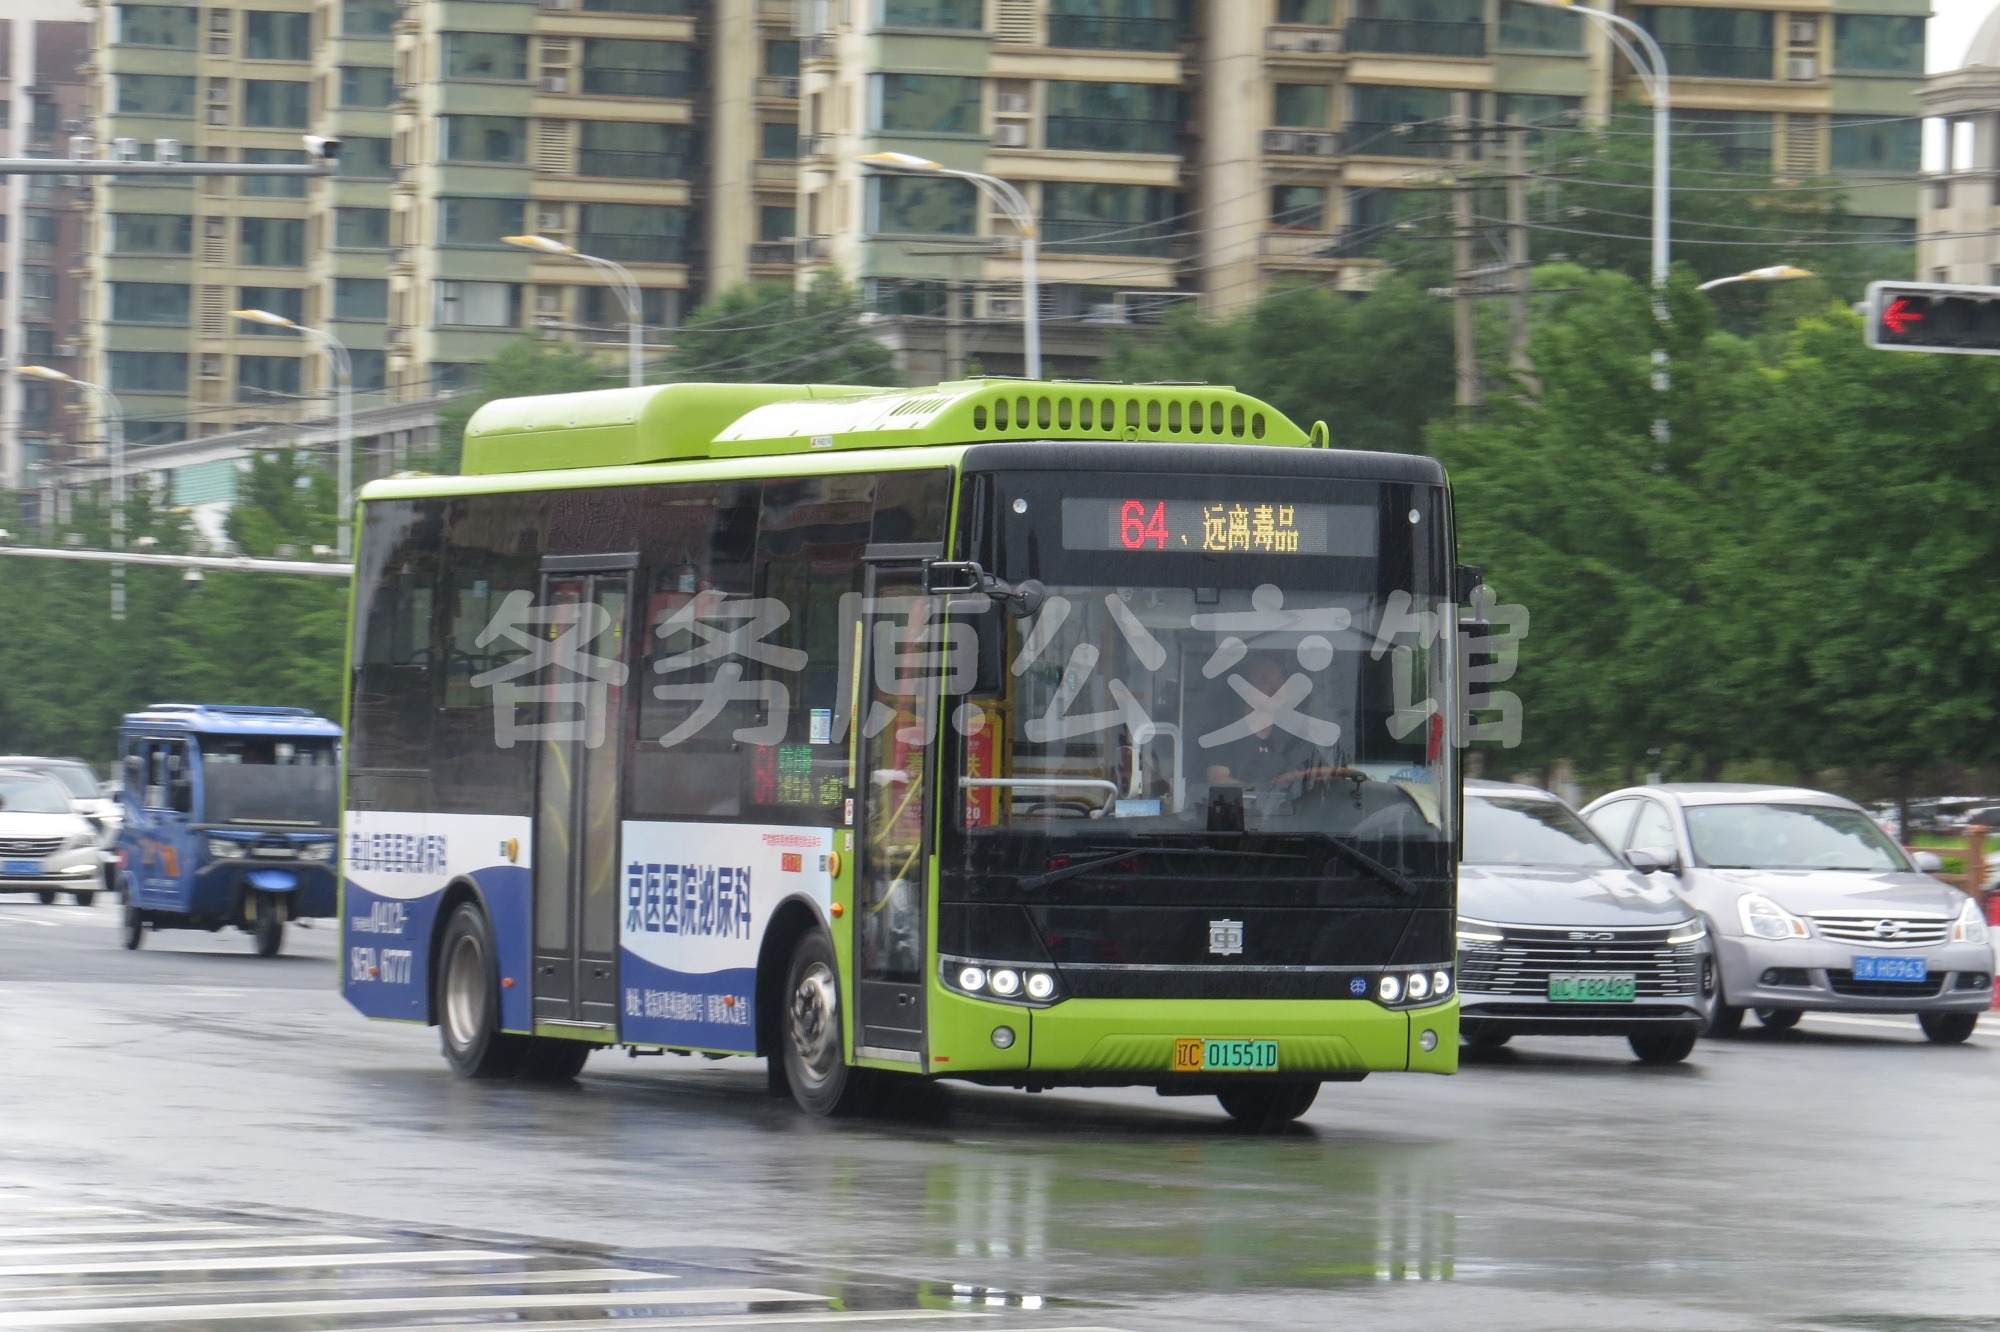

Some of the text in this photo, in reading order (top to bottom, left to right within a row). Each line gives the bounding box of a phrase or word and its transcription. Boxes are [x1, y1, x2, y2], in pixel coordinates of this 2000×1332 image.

[1120, 500, 1169, 550] 64
[626, 861, 752, 940] 京医医院泌尿科
[1568, 932, 1615, 940] BYD
